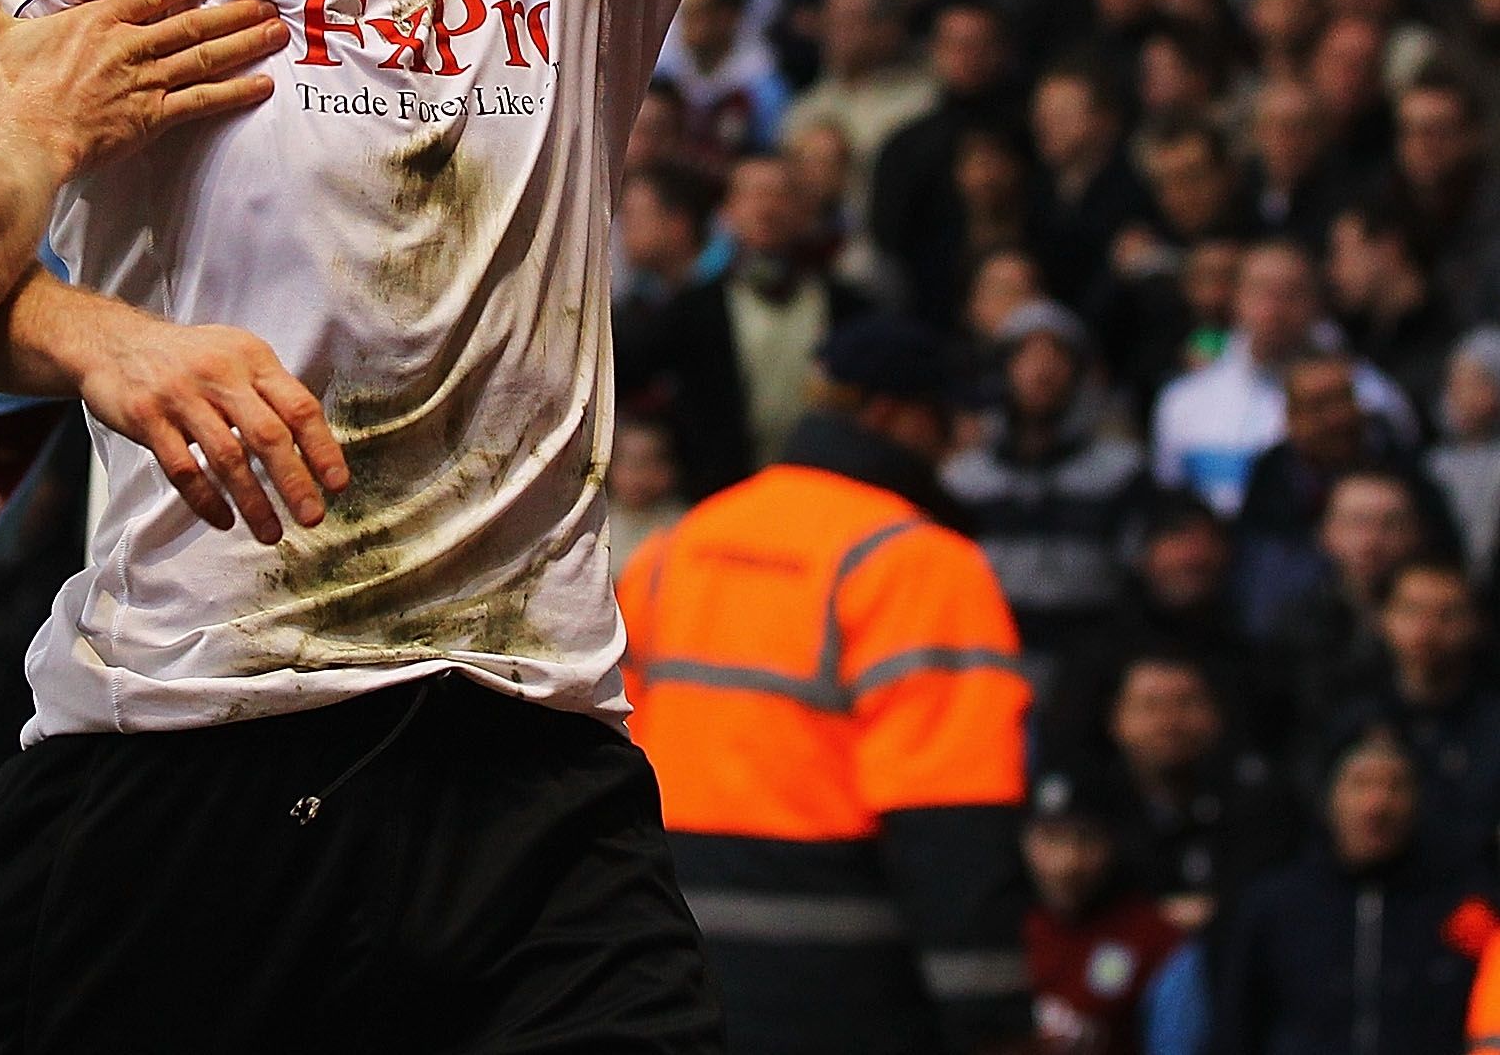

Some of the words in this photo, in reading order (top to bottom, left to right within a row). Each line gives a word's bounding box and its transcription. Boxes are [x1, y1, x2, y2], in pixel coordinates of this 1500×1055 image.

[296, 82, 389, 117] Trade
[397, 91, 469, 123] Forex
[474, 86, 534, 116] Like
